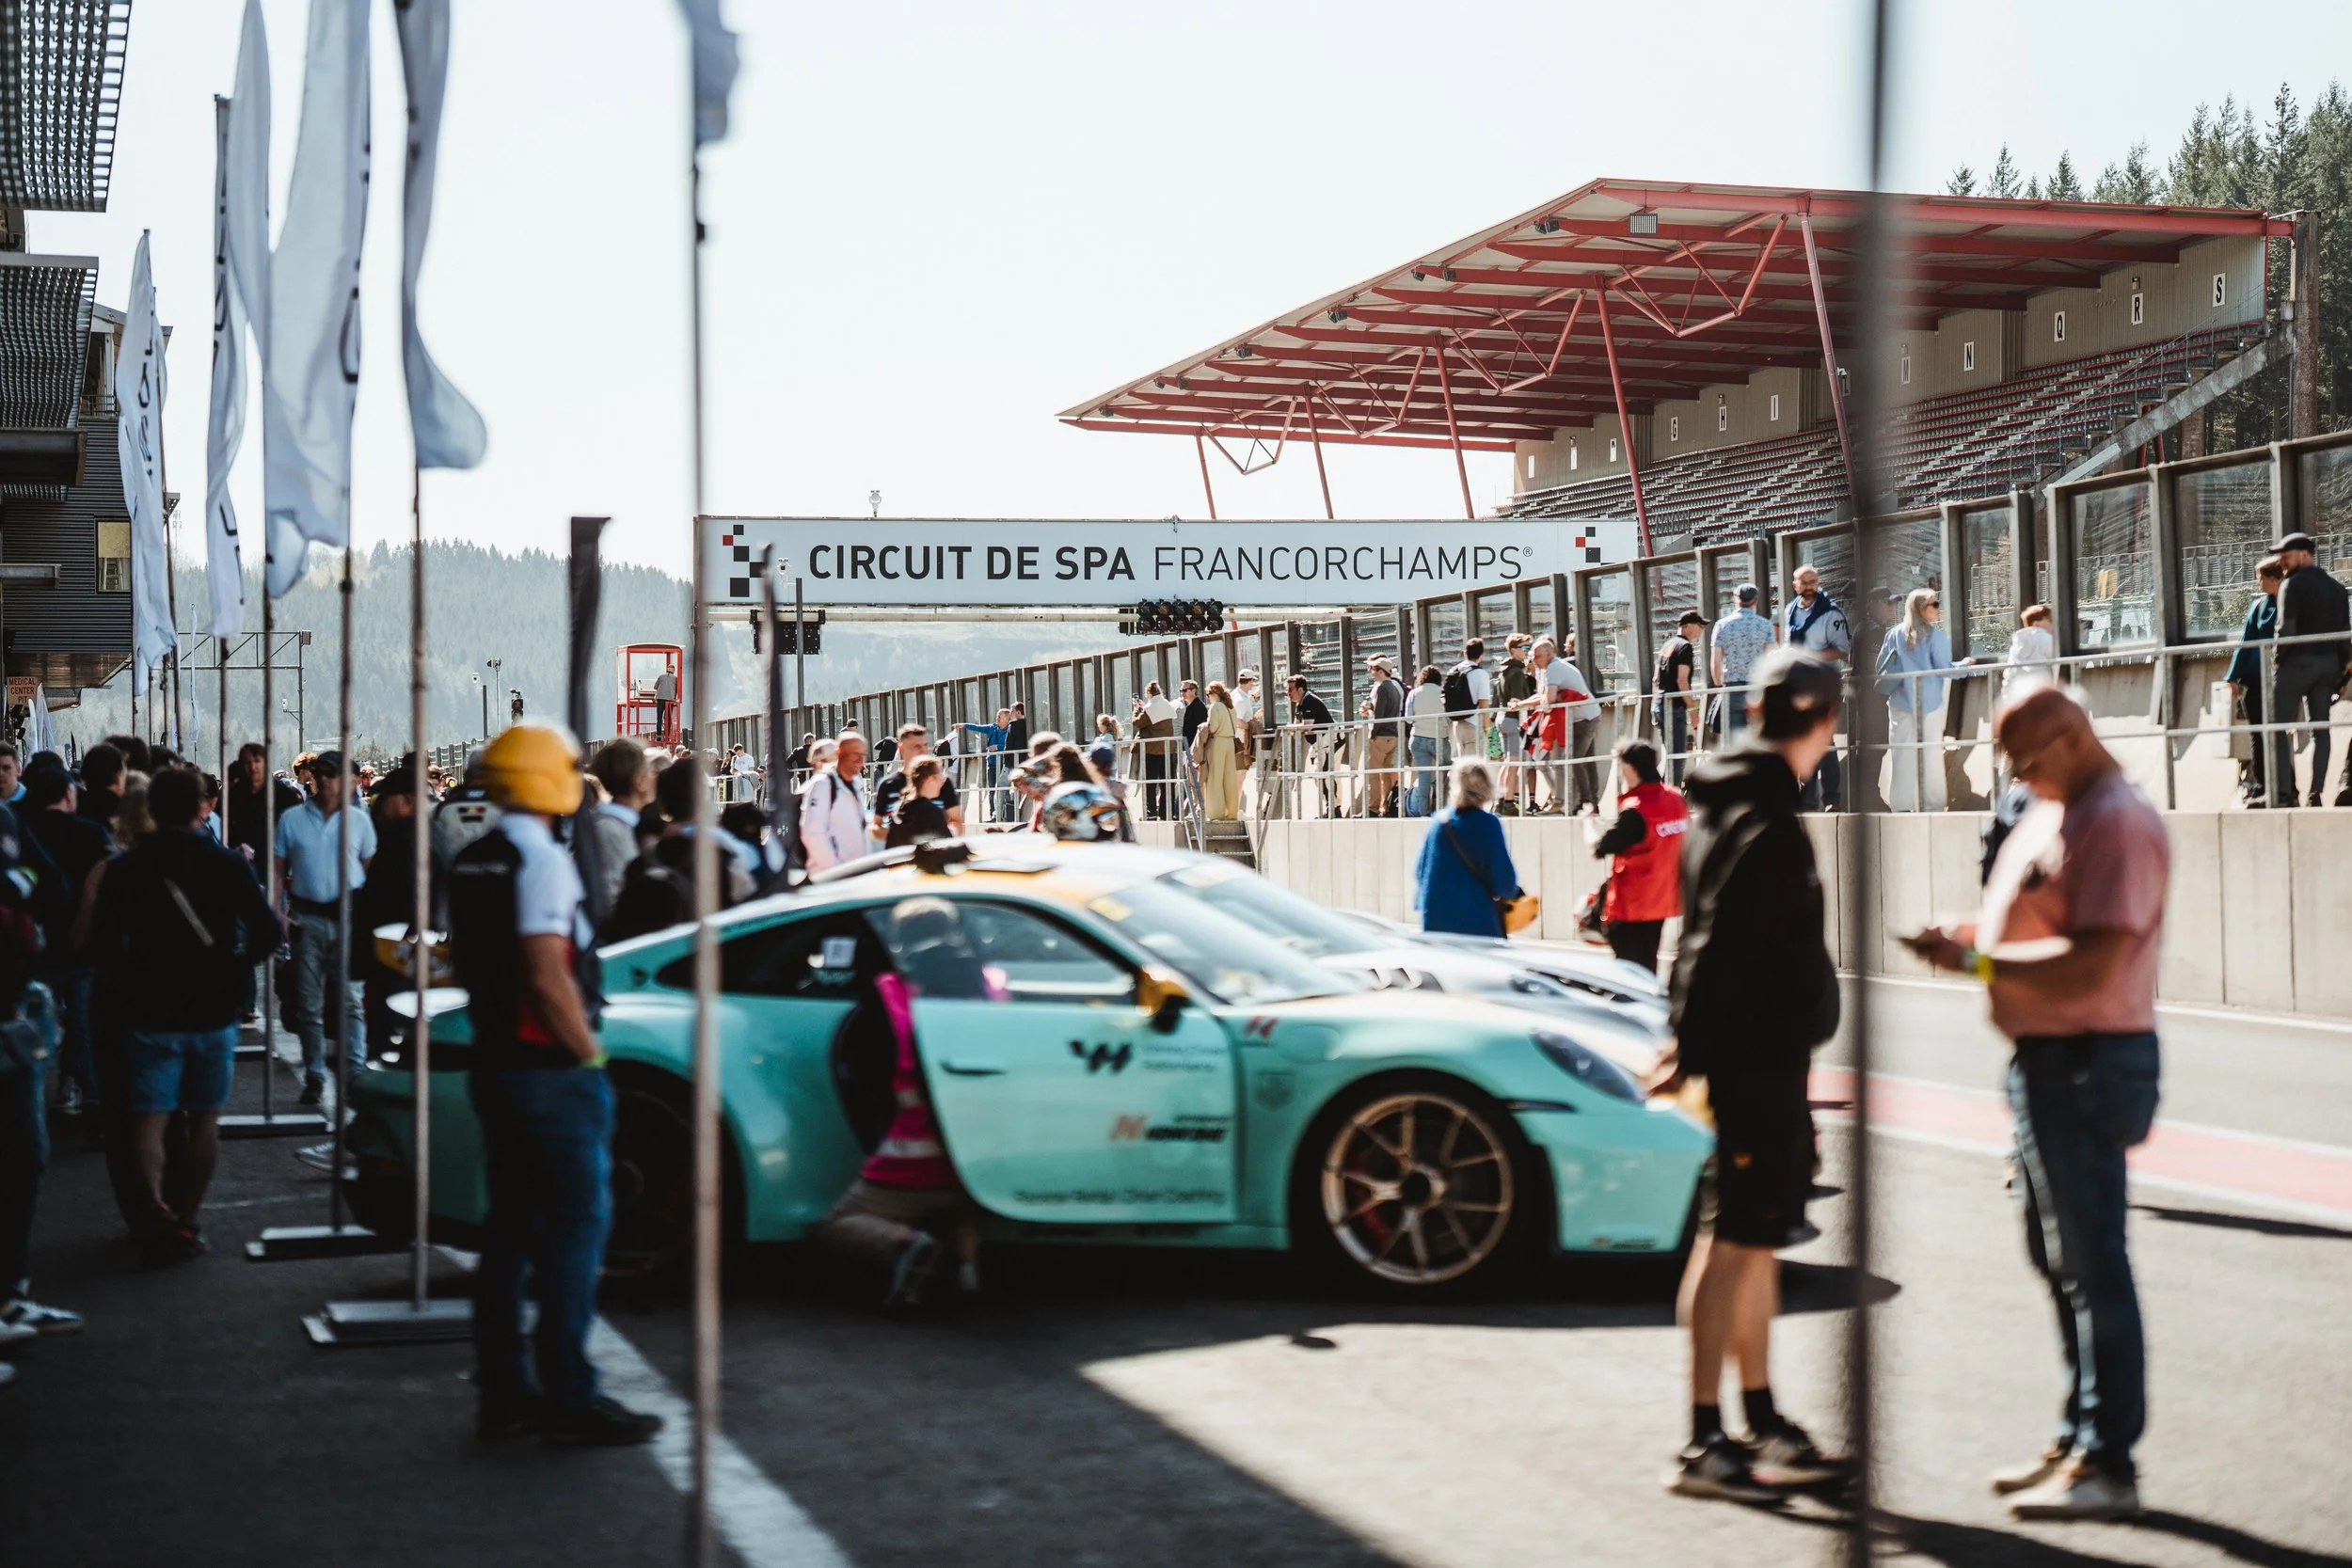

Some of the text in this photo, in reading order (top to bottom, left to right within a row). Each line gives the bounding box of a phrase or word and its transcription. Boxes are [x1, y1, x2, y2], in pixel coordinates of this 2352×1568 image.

[2216, 277, 2222, 304] S
[2134, 296, 2140, 322] R
[2057, 314, 2063, 340] Q
[1966, 344, 1972, 369] N
[1673, 419, 1677, 439] G
[1721, 407, 1725, 429] H
[810, 545, 972, 579] CIRCUIT
[988, 546, 1040, 579] DE
[1055, 546, 1136, 579] SPA
[1833, 619, 1846, 632] 97
[8, 677, 36, 686] MEDICAL
[10, 687, 35, 695] CENTER
